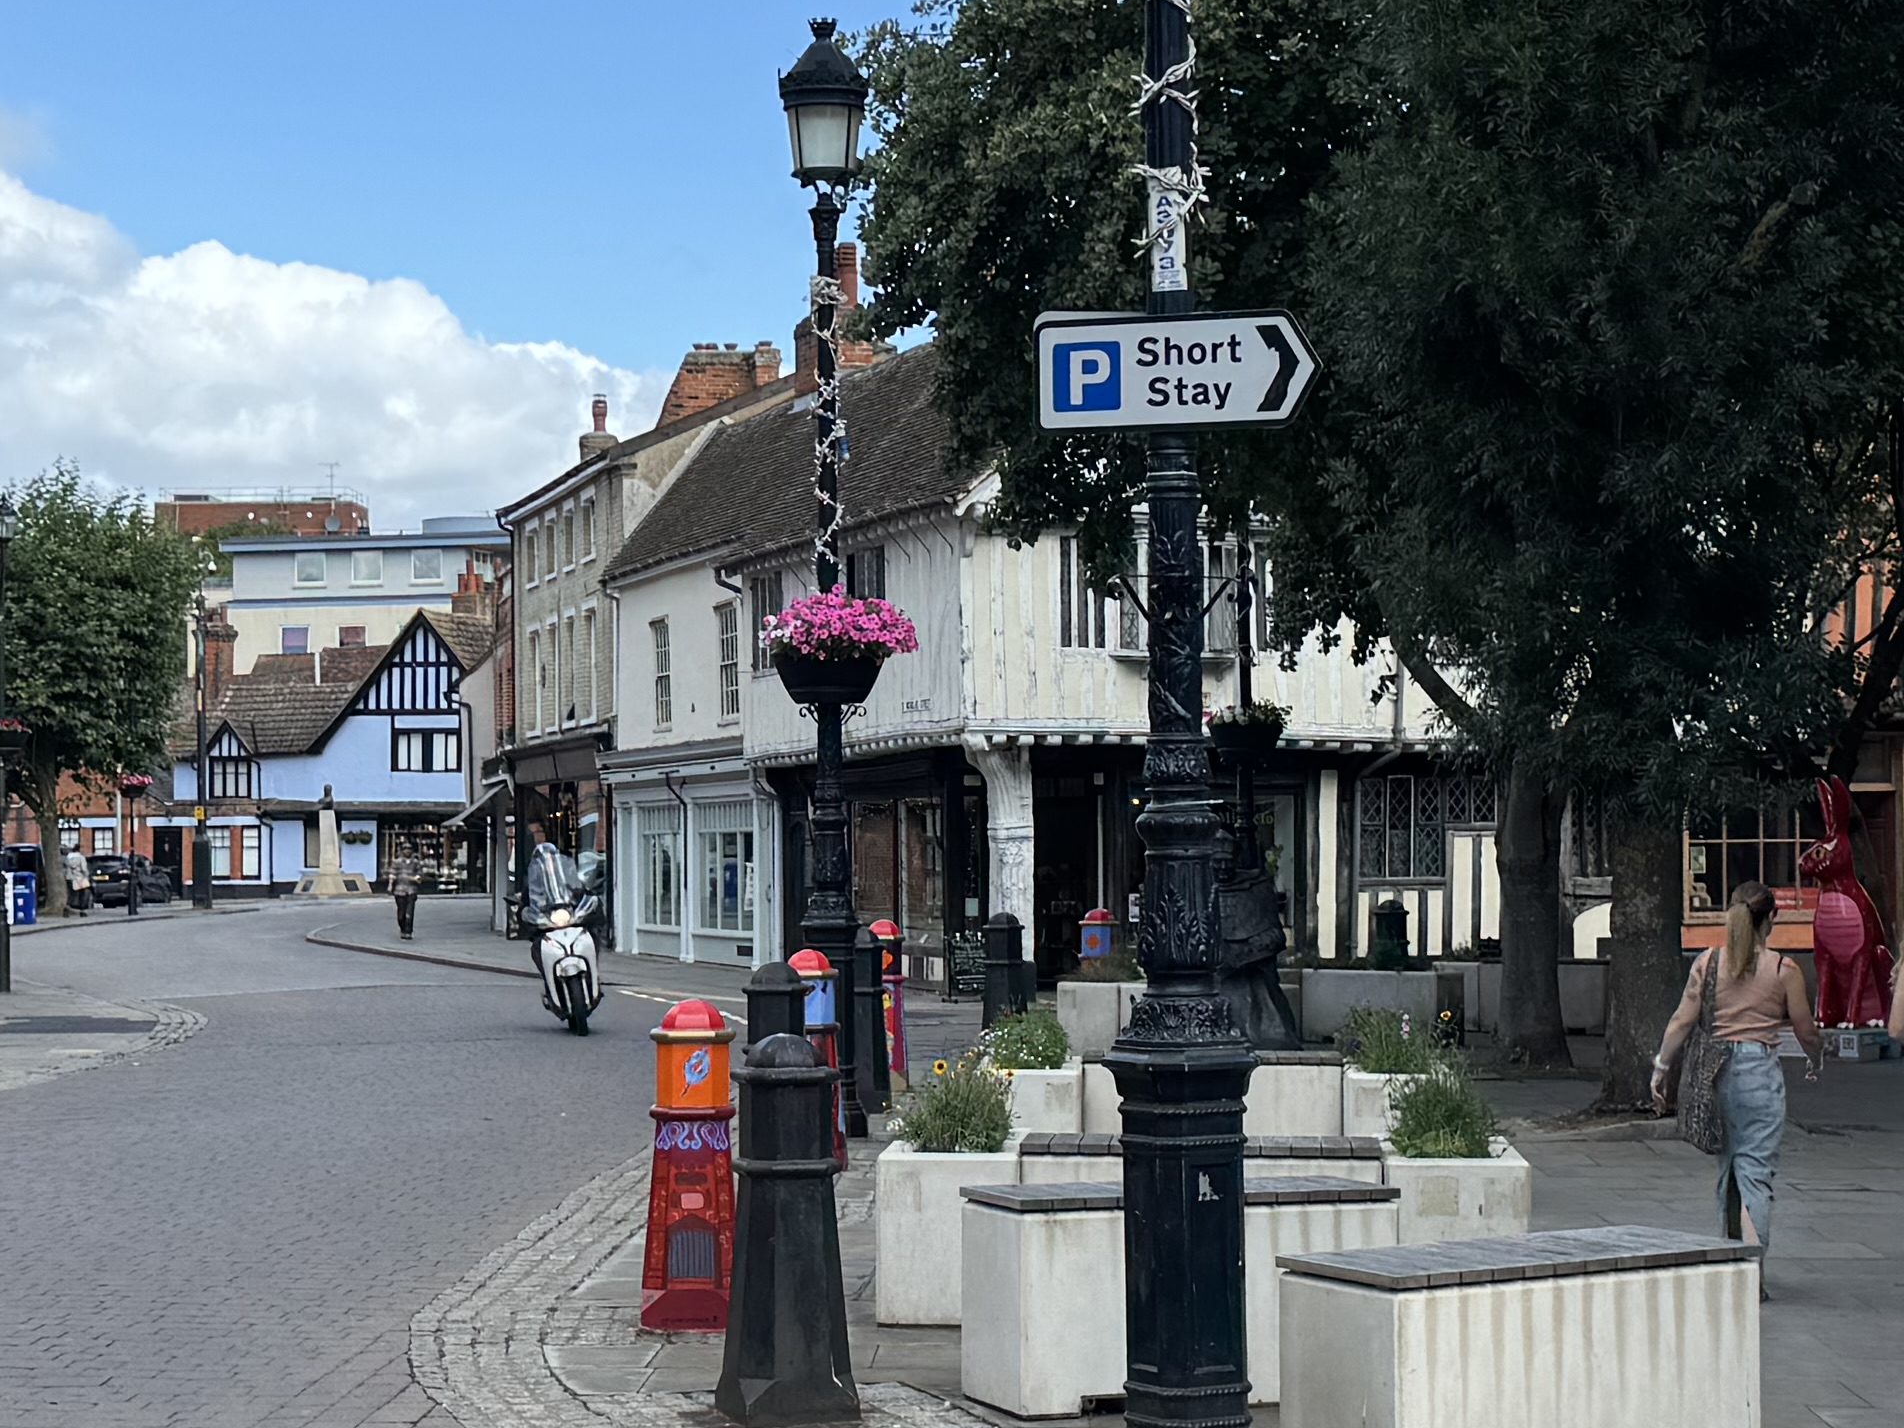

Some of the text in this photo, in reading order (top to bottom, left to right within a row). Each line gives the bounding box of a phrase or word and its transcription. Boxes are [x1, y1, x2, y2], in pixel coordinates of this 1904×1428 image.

[1135, 333, 1242, 368] Short
[1069, 349, 1111, 406] P
[1146, 376, 1232, 411] Stay
